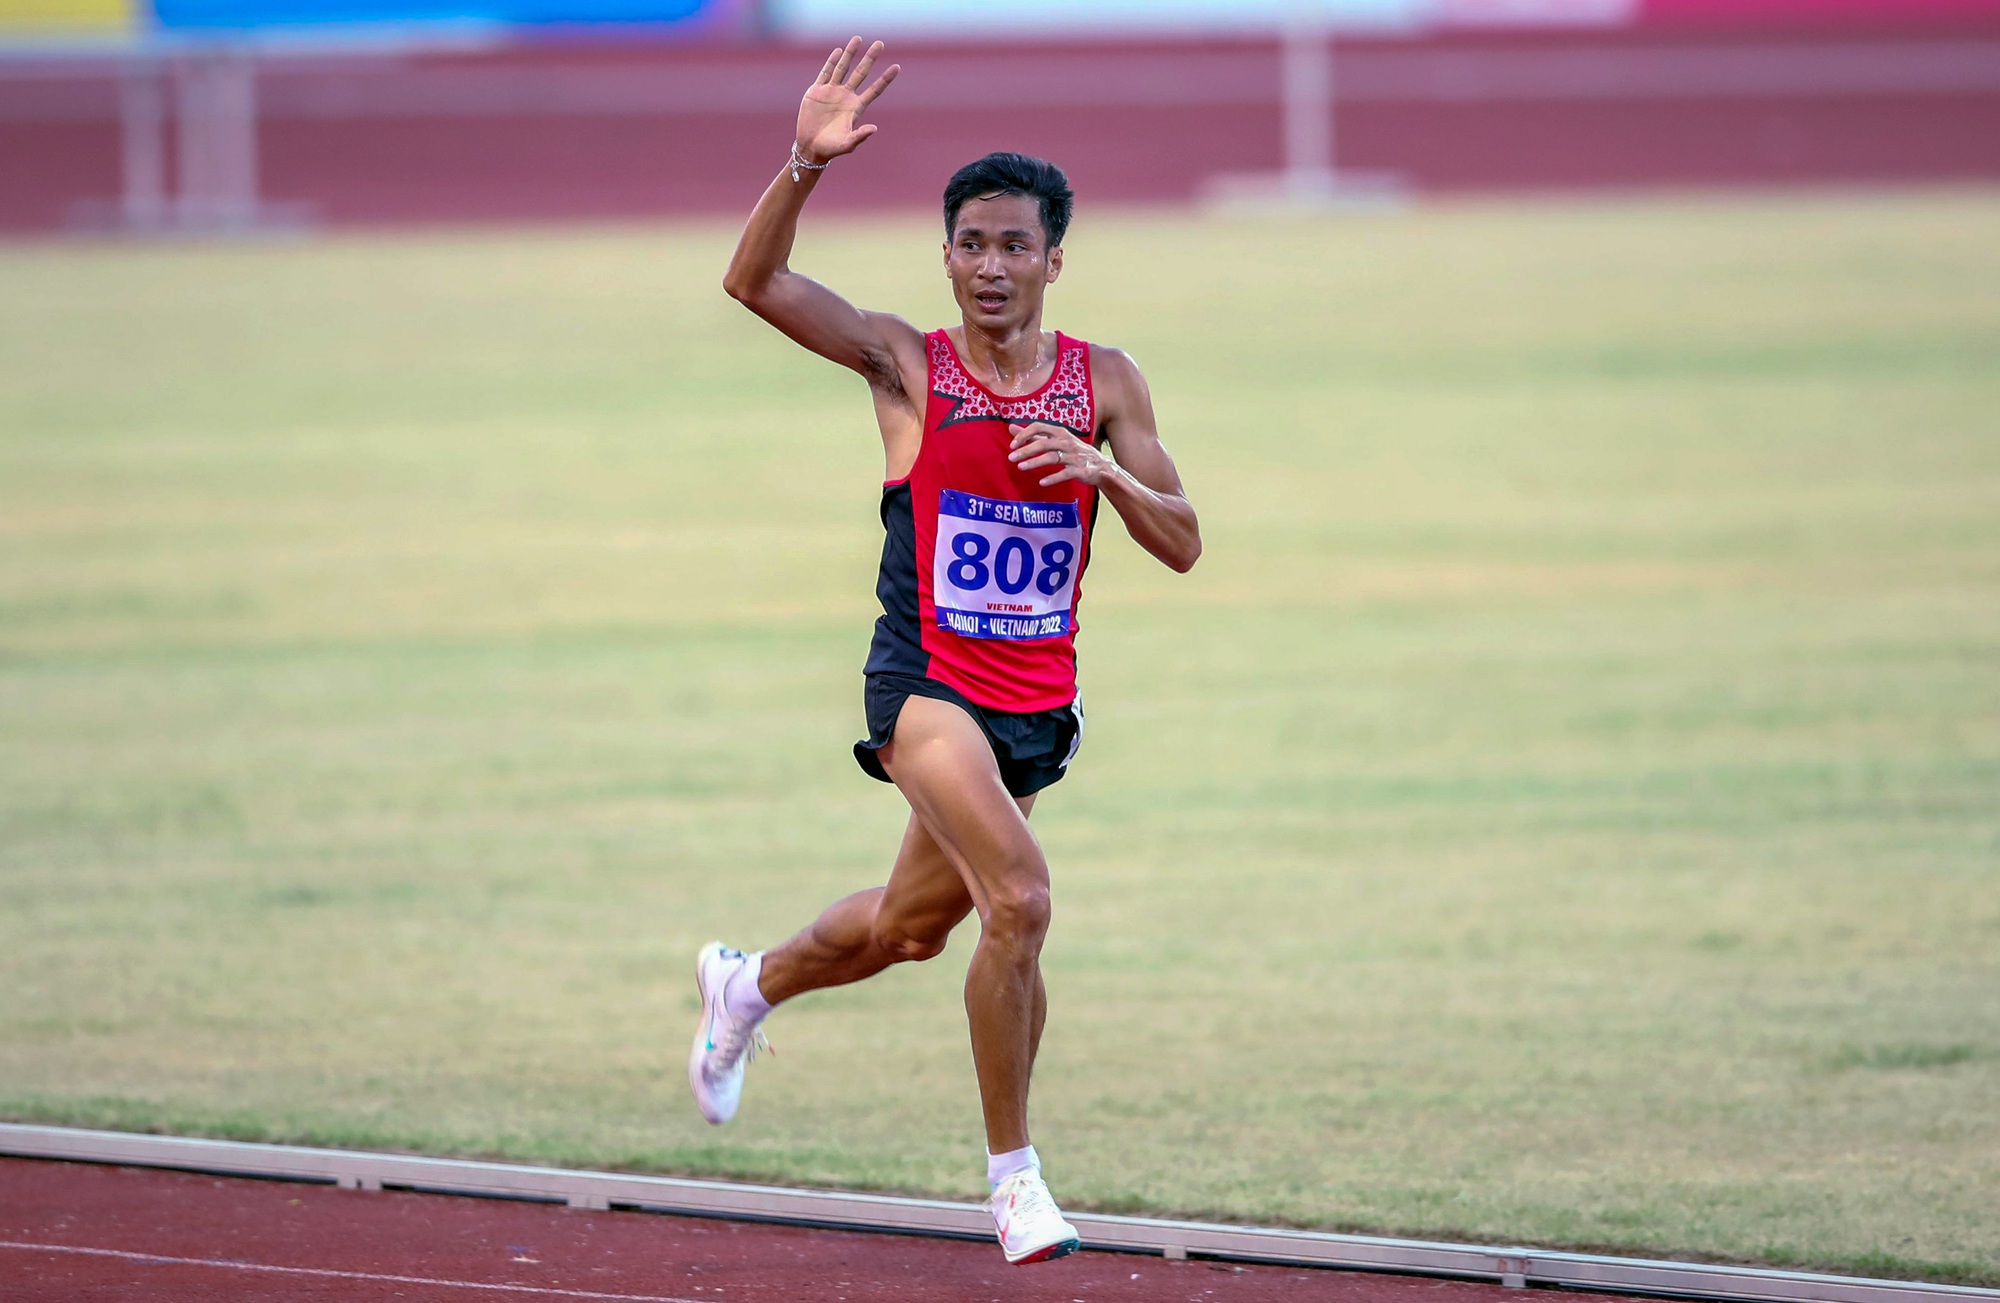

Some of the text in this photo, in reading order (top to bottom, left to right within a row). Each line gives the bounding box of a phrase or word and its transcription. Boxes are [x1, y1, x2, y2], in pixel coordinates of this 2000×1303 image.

[994, 504, 1020, 524] SEA
[1022, 506, 1064, 524] Games
[947, 532, 1074, 596] 808
[986, 602, 1033, 612] VIETNAM
[946, 612, 979, 633] HANOI
[989, 617, 1039, 636] VIETNAM
[1038, 615, 1061, 634] 2022
